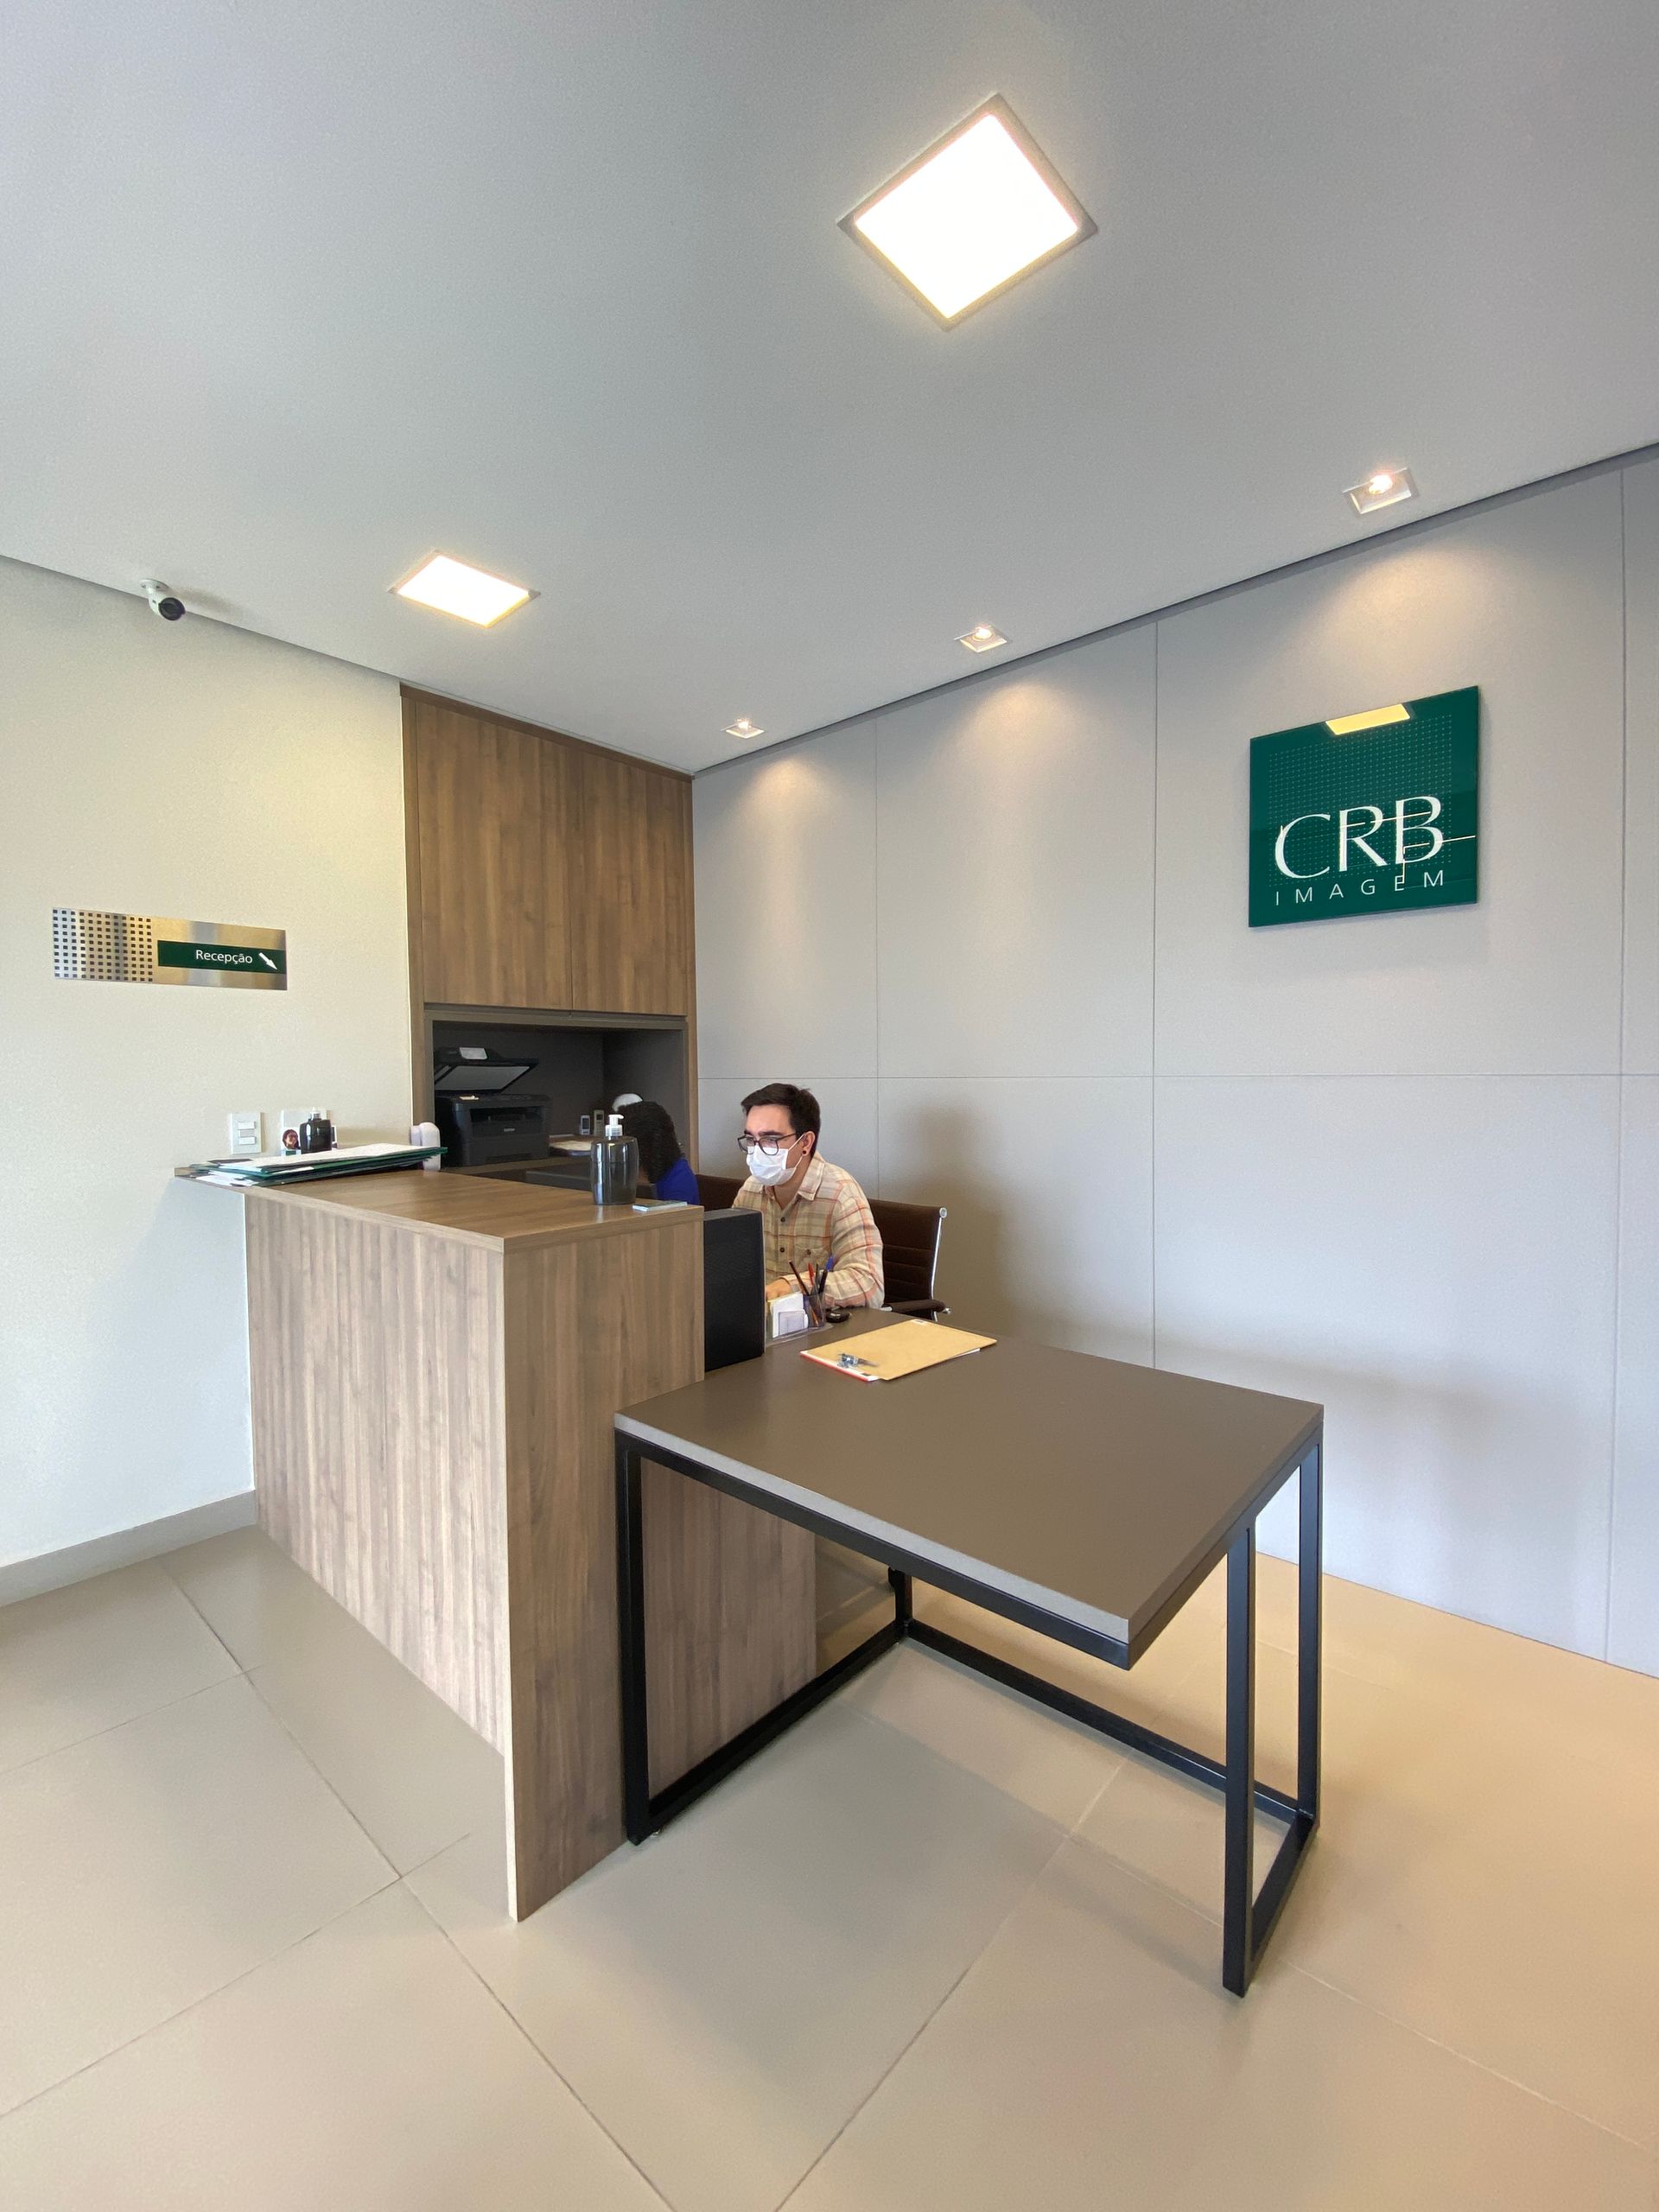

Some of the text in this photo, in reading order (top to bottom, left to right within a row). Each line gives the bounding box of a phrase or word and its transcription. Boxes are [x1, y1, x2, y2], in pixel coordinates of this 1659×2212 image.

[1274, 796, 1444, 879] CRB
[1275, 869, 1444, 906] IMAGEM
[195, 949, 253, 964] Recepção
